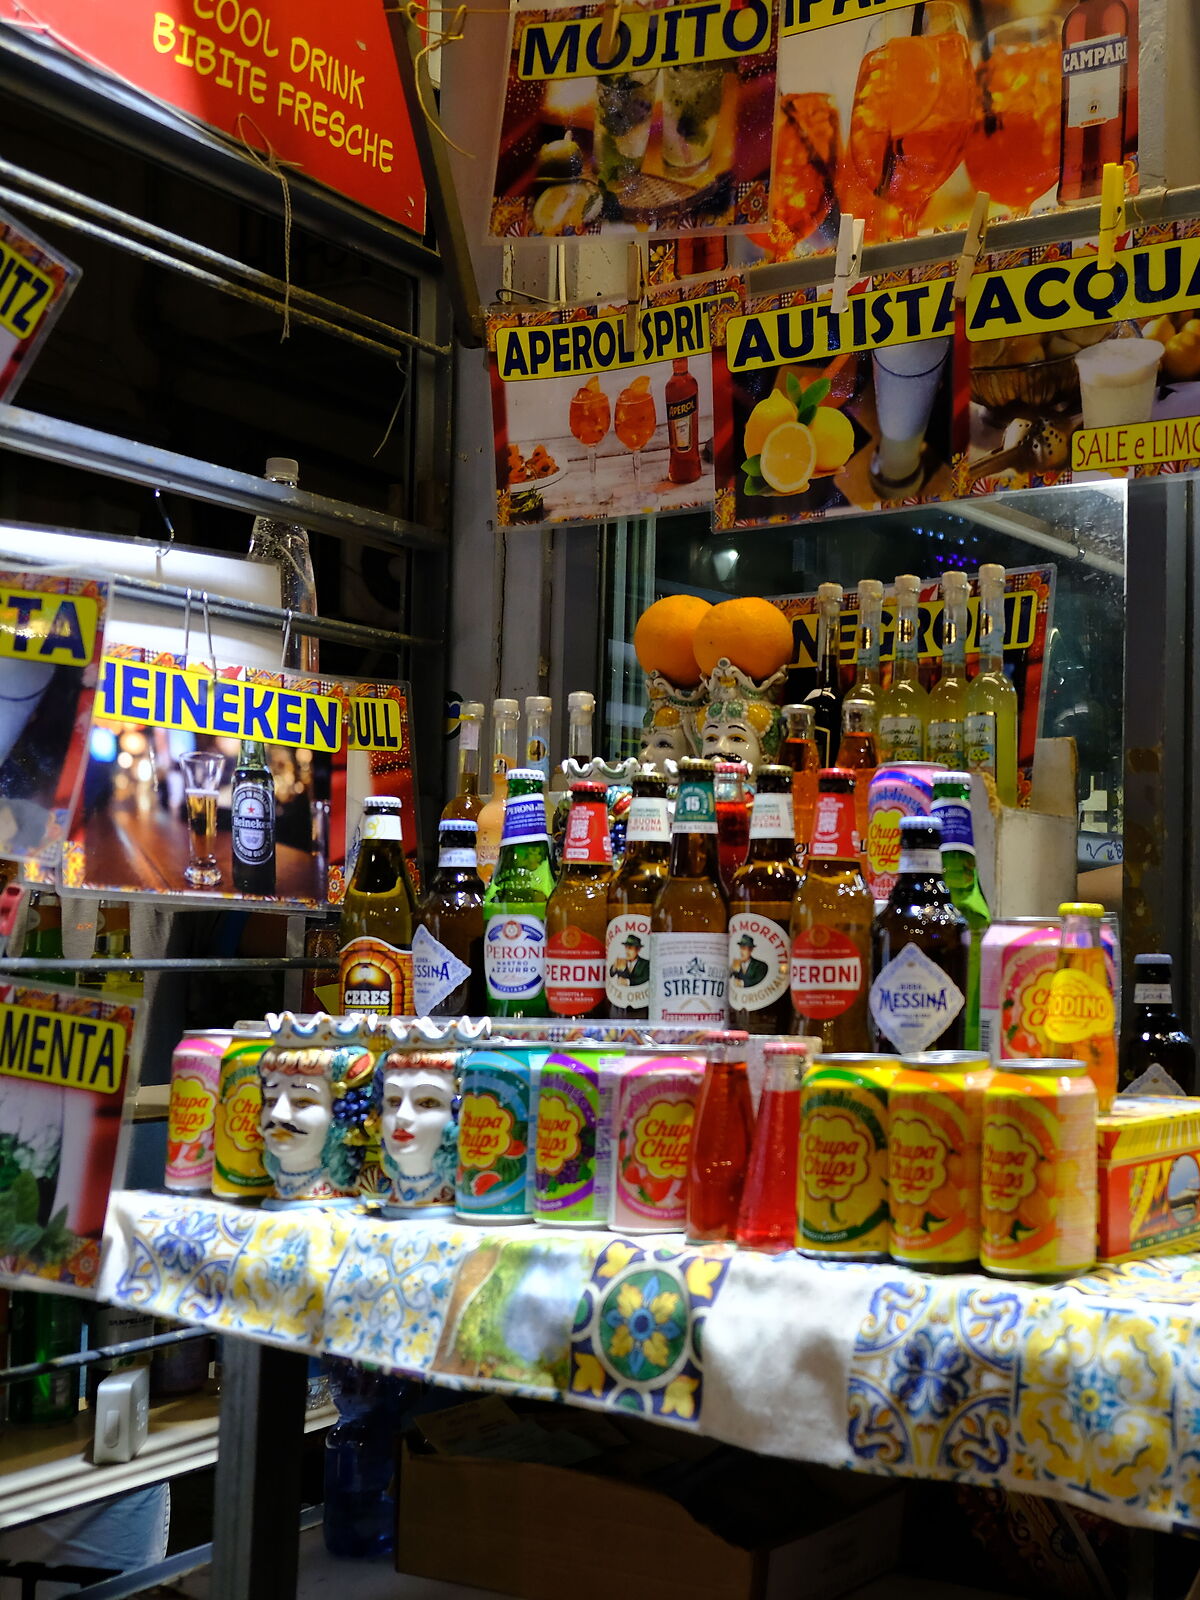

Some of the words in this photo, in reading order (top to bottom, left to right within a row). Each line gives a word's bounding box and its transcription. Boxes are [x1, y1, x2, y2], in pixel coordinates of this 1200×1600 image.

[193, 0, 279, 57] COOL
[290, 37, 365, 110] DRINK
[522, 3, 769, 76] MOJITO
[1063, 41, 1127, 73] CAMPARI
[153, 12, 267, 104] BIBITE
[278, 82, 394, 173] FRESCHE
[0, 247, 49, 333] ITZ
[503, 316, 637, 376] APEROL
[641, 300, 719, 357] SPRI
[733, 281, 955, 368] AUTISTA
[669, 401, 695, 417] APEROL
[1076, 430, 1128, 466] SALE
[1134, 435, 1146, 459] e
[3, 598, 86, 660] TA
[98, 661, 338, 749] HEINEKEN
[486, 945, 545, 959] PERONI
[739, 921, 788, 965] MORETTI
[413, 961, 450, 981] ESSINA
[546, 964, 606, 982] PERONI
[663, 979, 725, 997] STRETTO
[792, 965, 857, 983] PERONI
[344, 989, 390, 1005] CERES
[879, 986, 947, 1012] MESSINA
[1, 1010, 115, 1089] MENTA
[805, 1134, 860, 1159] Chupa
[805, 1155, 856, 1189] Chups
